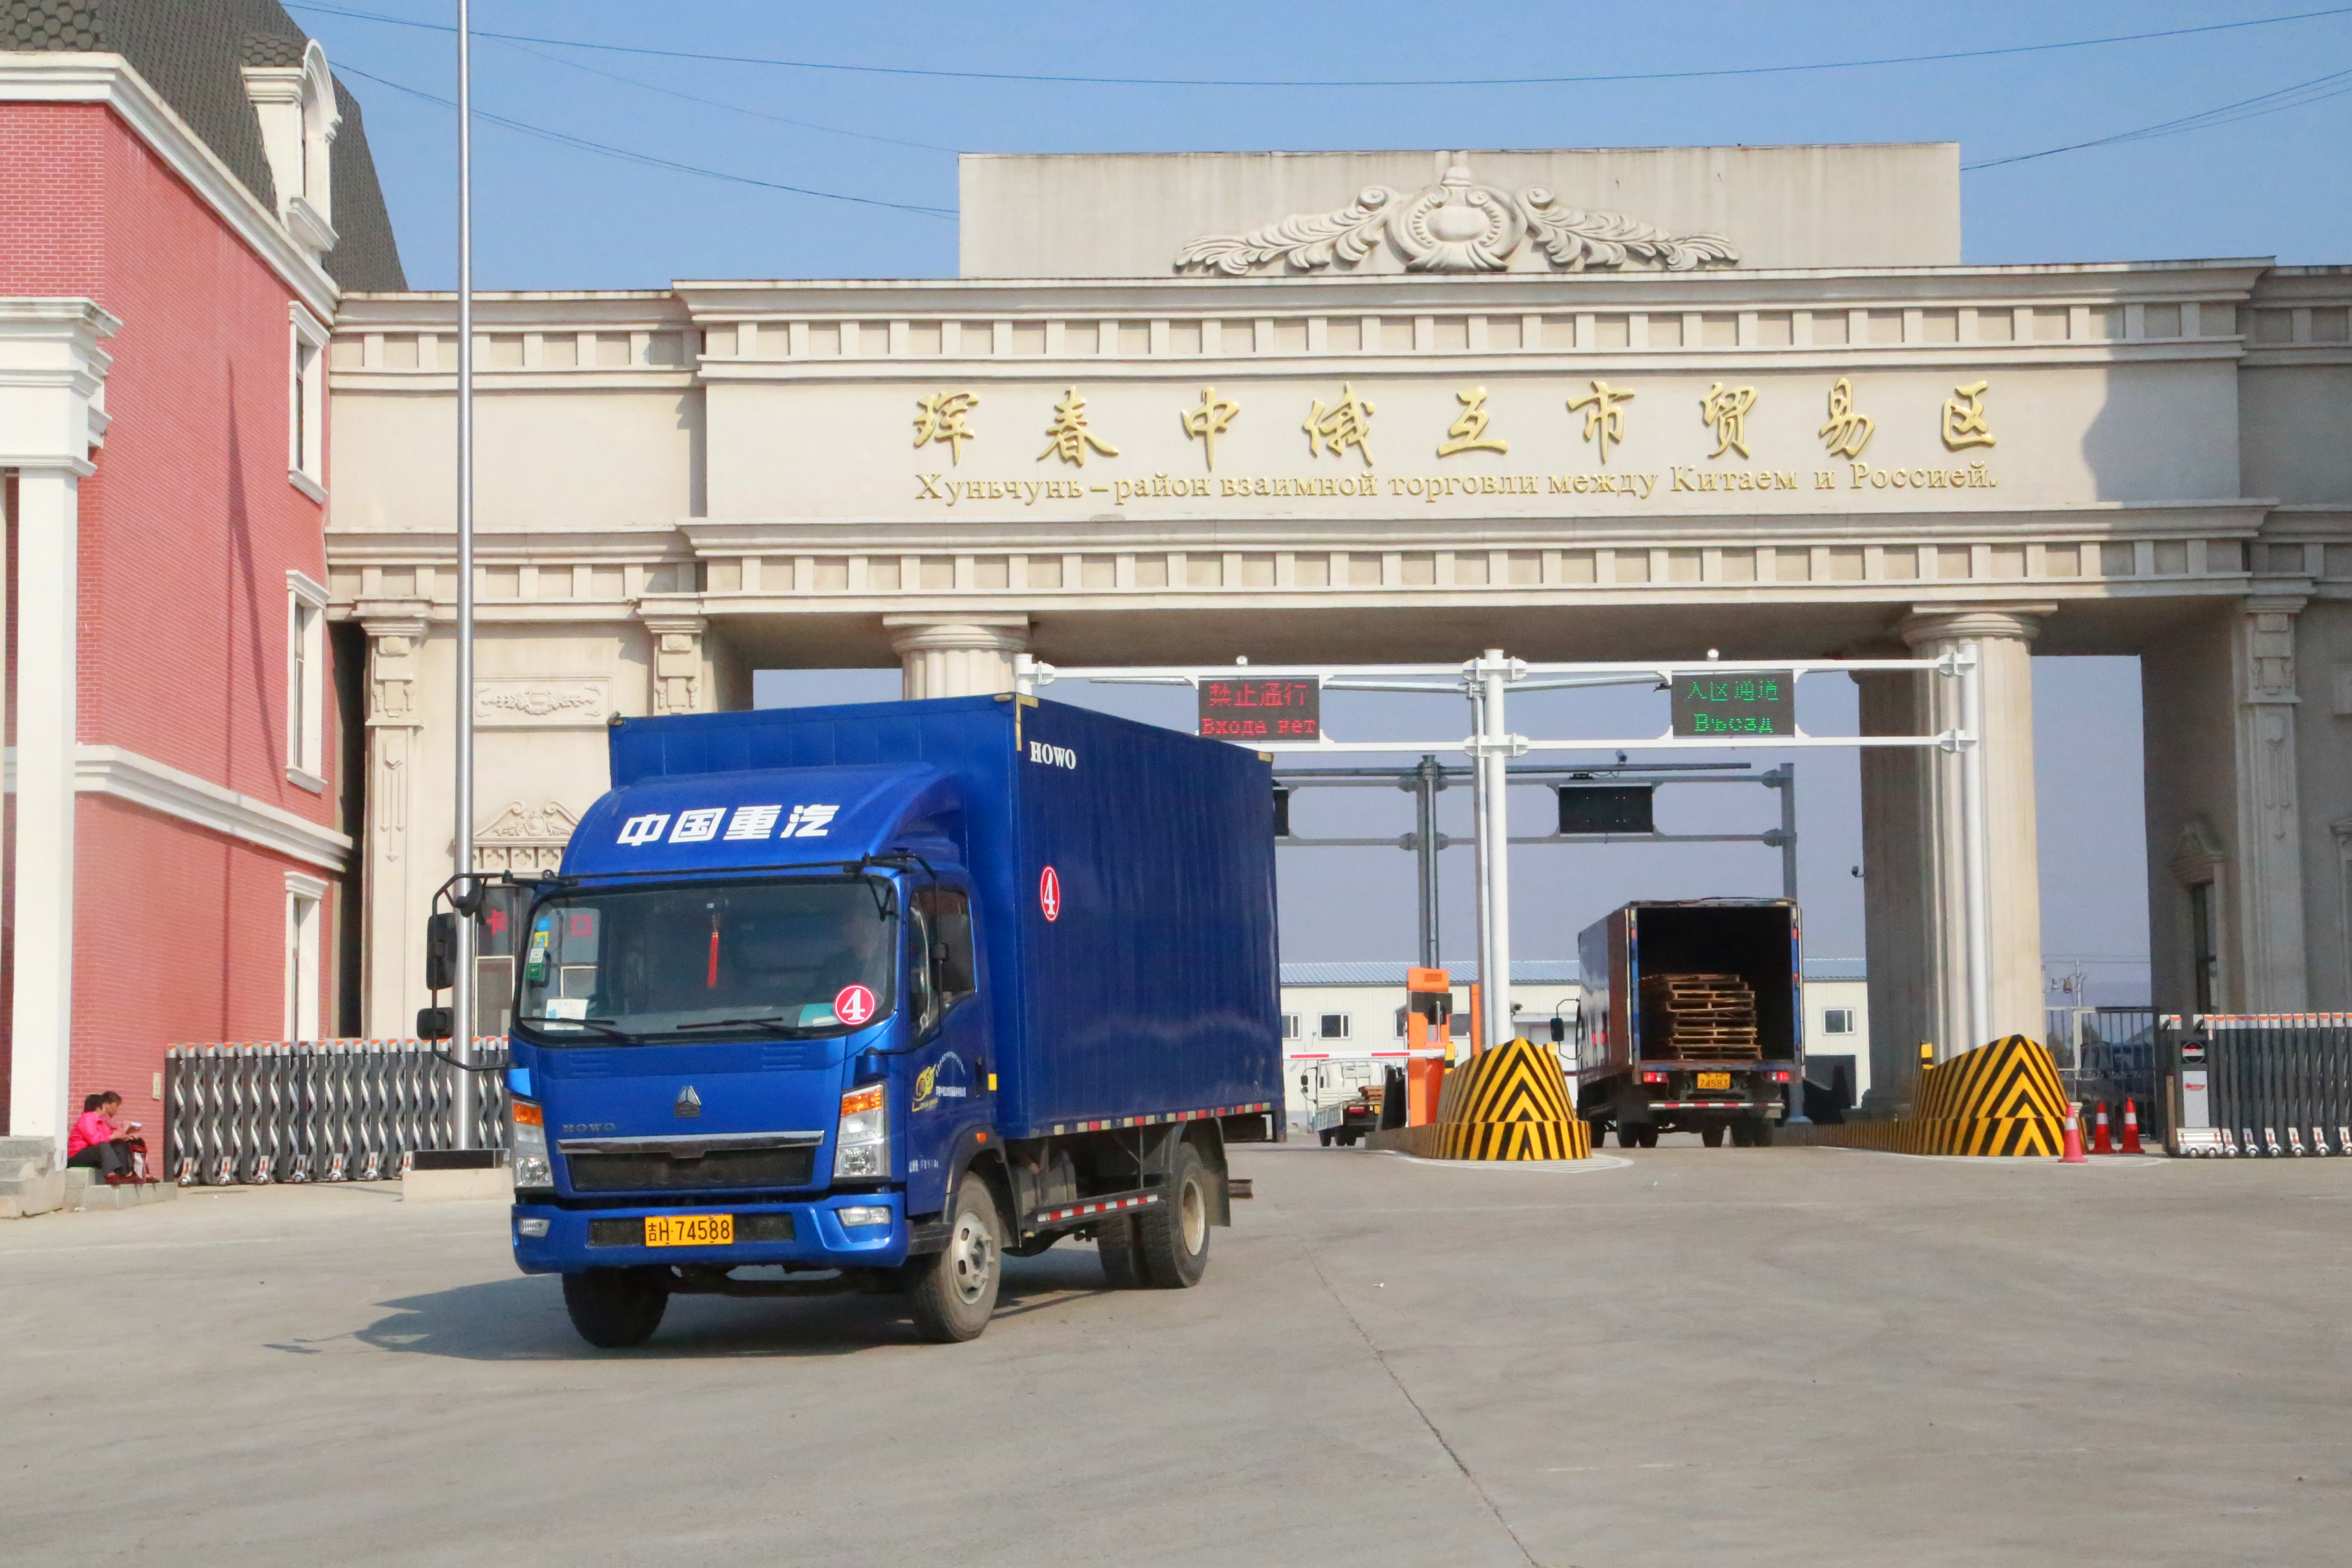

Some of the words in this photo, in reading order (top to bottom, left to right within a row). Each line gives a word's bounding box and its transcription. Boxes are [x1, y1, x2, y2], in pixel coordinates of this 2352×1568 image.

[913, 378, 1997, 473] 珲春中俄互市贸易区
[915, 473, 1084, 506] Хуньчунь
[1115, 471, 1213, 506] район
[1220, 471, 1378, 497] взаимной
[1388, 474, 1538, 503] торговли
[1548, 474, 1659, 499] между
[1670, 465, 1799, 492] Китаем
[1815, 471, 1835, 489] и
[1850, 460, 1997, 489] Россией.
[1209, 682, 1308, 706] 禁止通行
[1030, 741, 1076, 770] HOWO
[616, 804, 840, 846] 中国重汽
[1044, 872, 1056, 915] 4
[842, 989, 866, 1020] 4
[563, 1123, 616, 1132] HOWO
